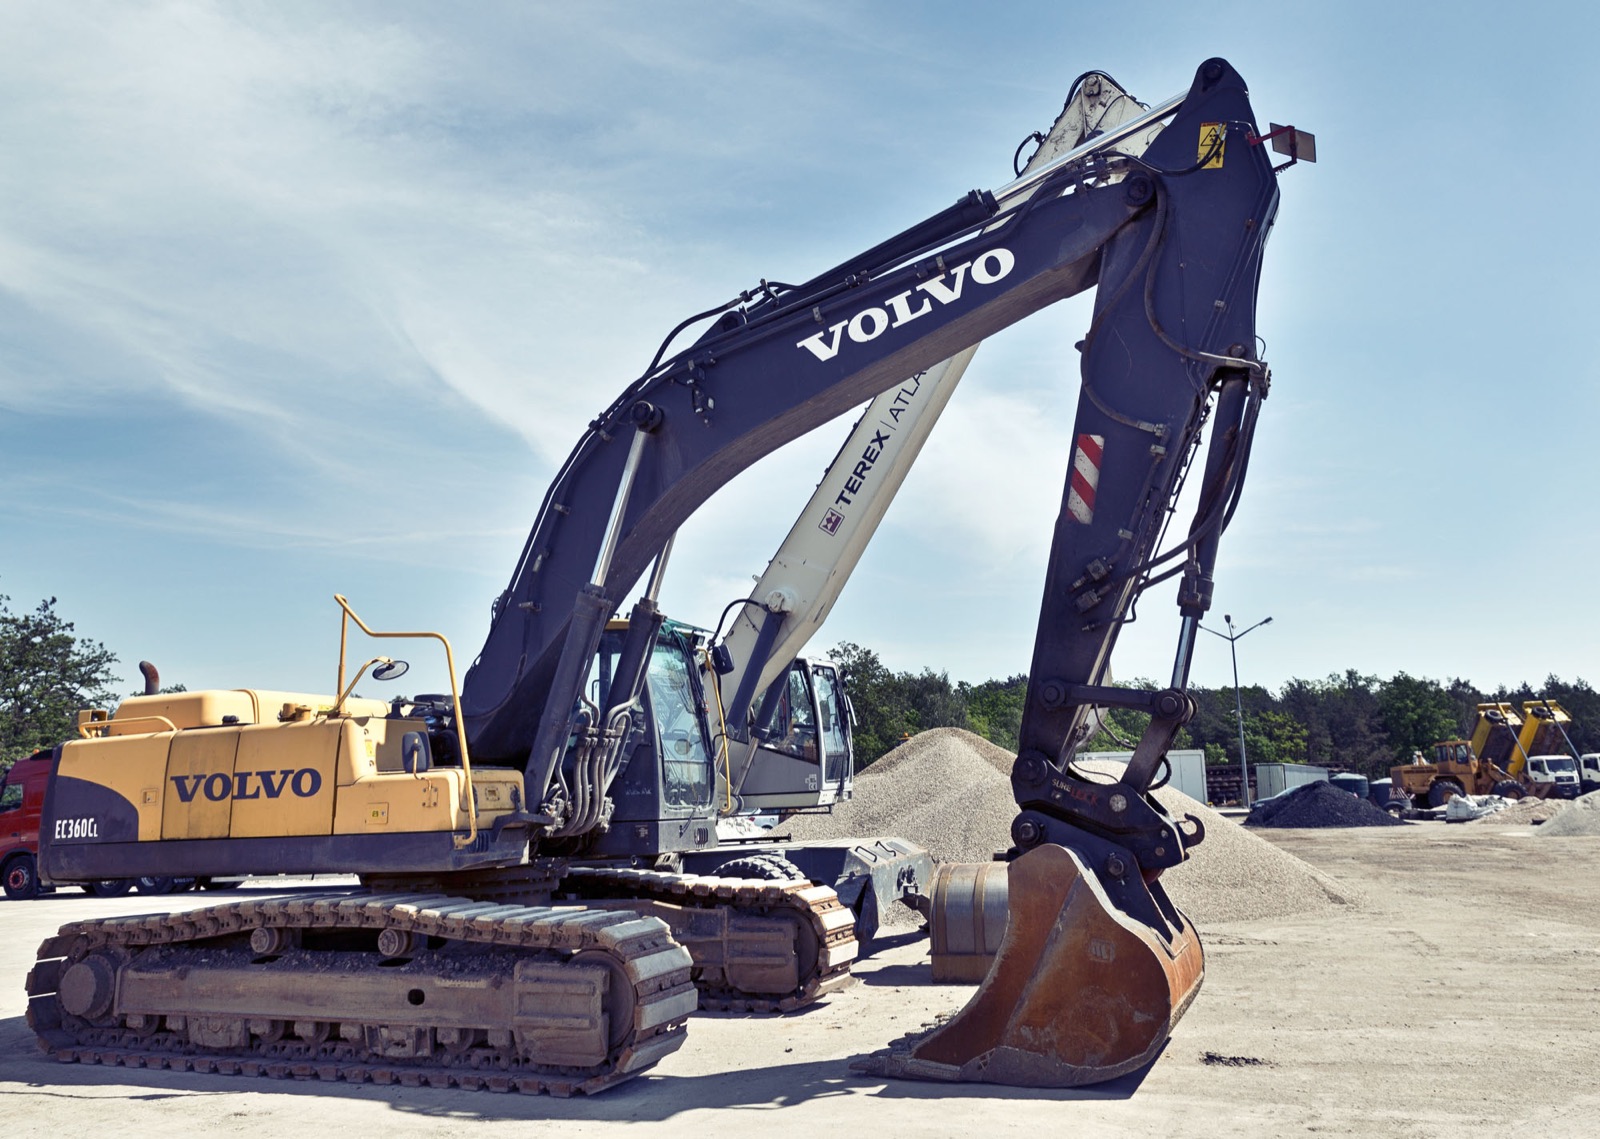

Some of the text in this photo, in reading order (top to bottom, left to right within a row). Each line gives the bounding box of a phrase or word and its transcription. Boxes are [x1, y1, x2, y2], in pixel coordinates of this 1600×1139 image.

[796, 248, 1015, 362] VOLVO
[835, 429, 890, 505] TEREX
[170, 768, 322, 802] VOLVO
